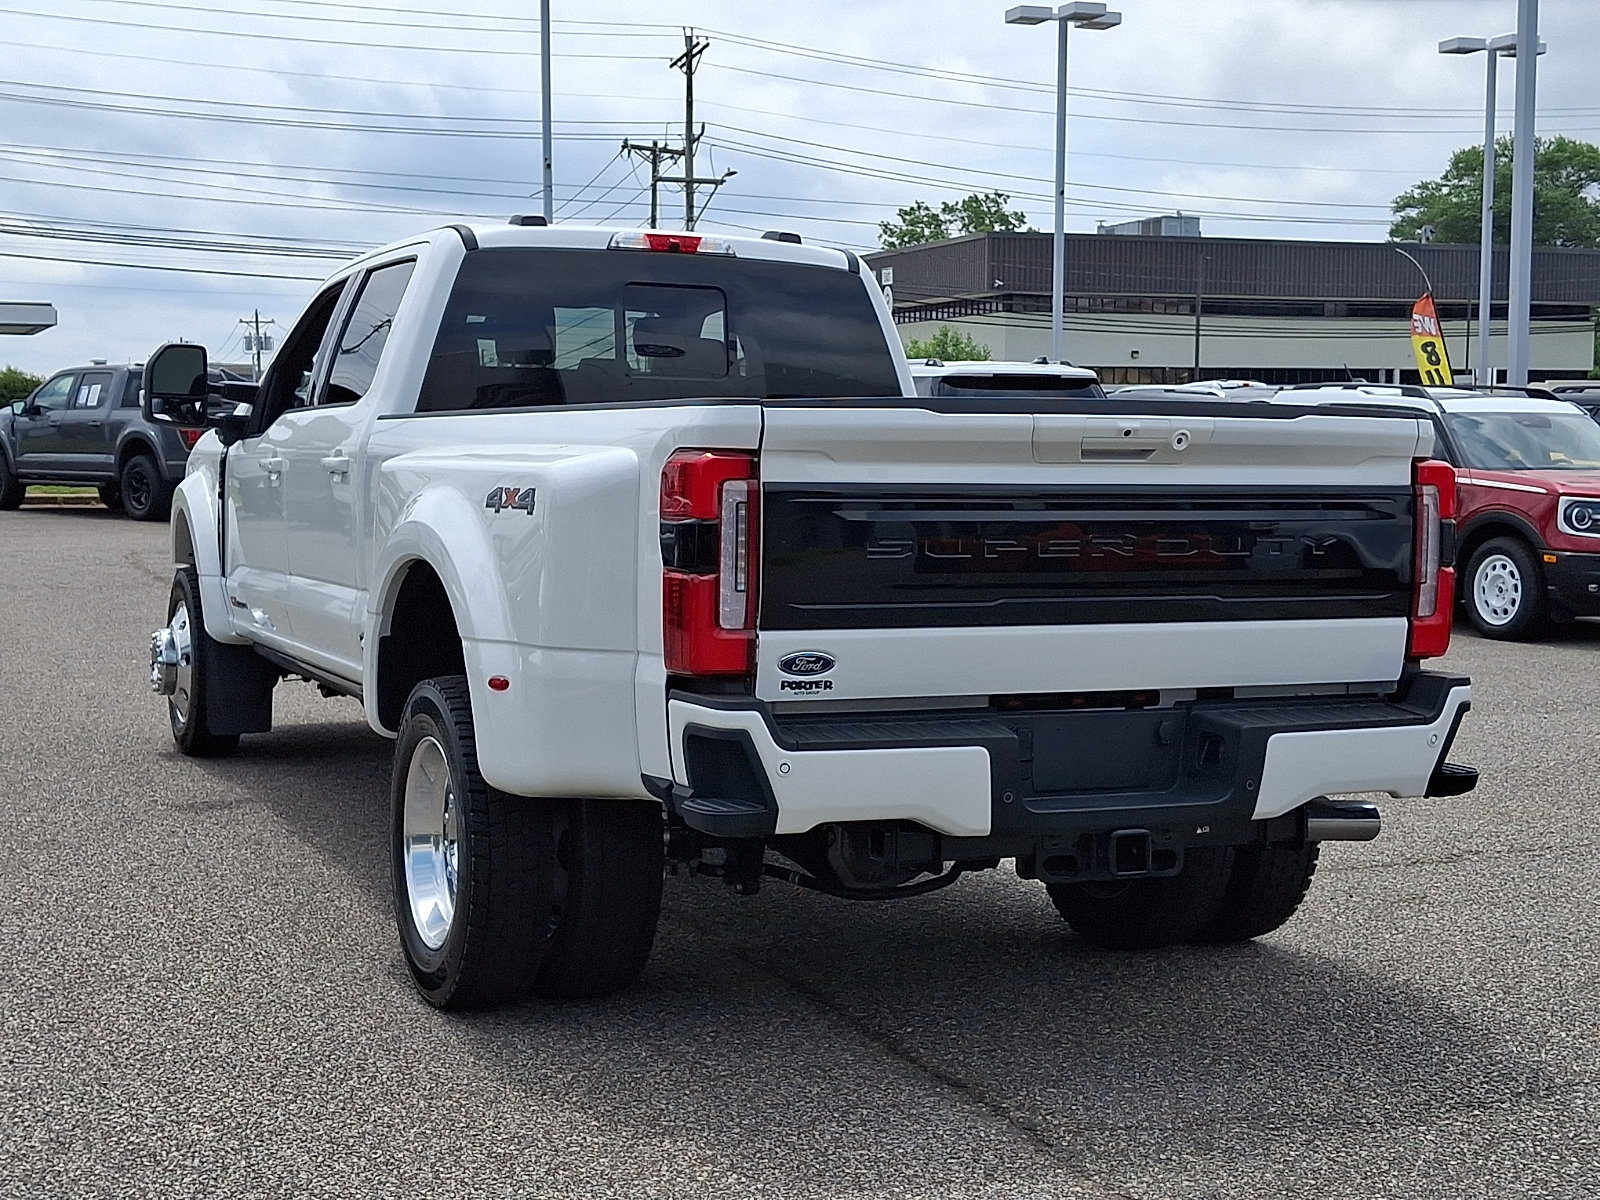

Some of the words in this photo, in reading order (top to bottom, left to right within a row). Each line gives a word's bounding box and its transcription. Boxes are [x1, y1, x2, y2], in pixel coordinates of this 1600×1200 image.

[866, 534, 1135, 559] SUPER
[1151, 534, 1340, 557] DUTY
[791, 656, 824, 671] Ford
[780, 679, 834, 691] PORTER
